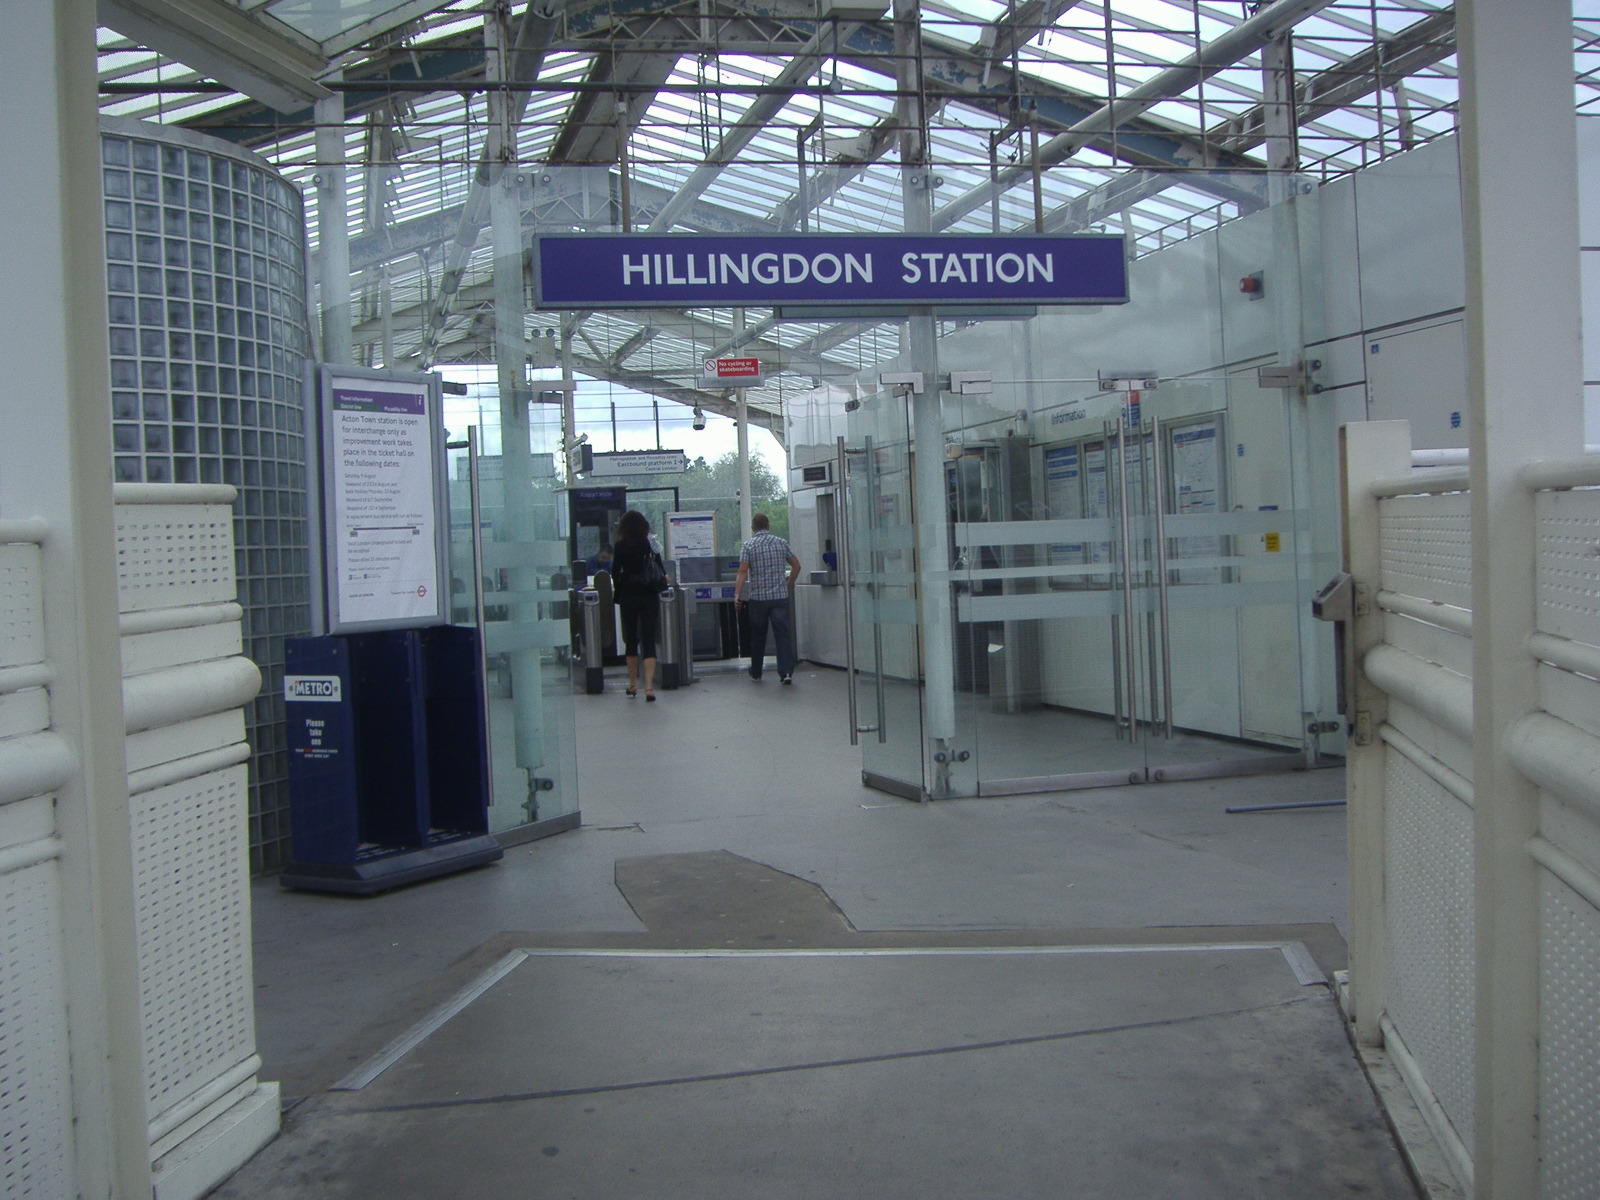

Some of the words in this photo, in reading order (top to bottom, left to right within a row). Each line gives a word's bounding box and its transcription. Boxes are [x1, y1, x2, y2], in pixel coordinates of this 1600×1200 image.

[622, 252, 873, 286] HILLINGDON
[901, 252, 1055, 285] STATION
[341, 415, 360, 424] Acton
[360, 415, 377, 424] Town
[377, 417, 398, 425] station
[404, 419, 419, 427] open
[1051, 408, 1087, 426] Information
[341, 425, 351, 433] for
[352, 426, 386, 436] interchange
[386, 428, 400, 437] only
[342, 437, 382, 446] improvement
[397, 439, 413, 447] takes
[343, 449, 360, 457] place
[367, 449, 378, 457] the
[378, 449, 396, 457] ticket
[395, 449, 407, 457] hall
[355, 459, 383, 469] following
[617, 460, 647, 468] Eastbound
[648, 460, 673, 468] platform
[296, 681, 332, 696] METRO
[305, 718, 325, 727] Please
[309, 728, 323, 737] take
[311, 738, 322, 746] one
